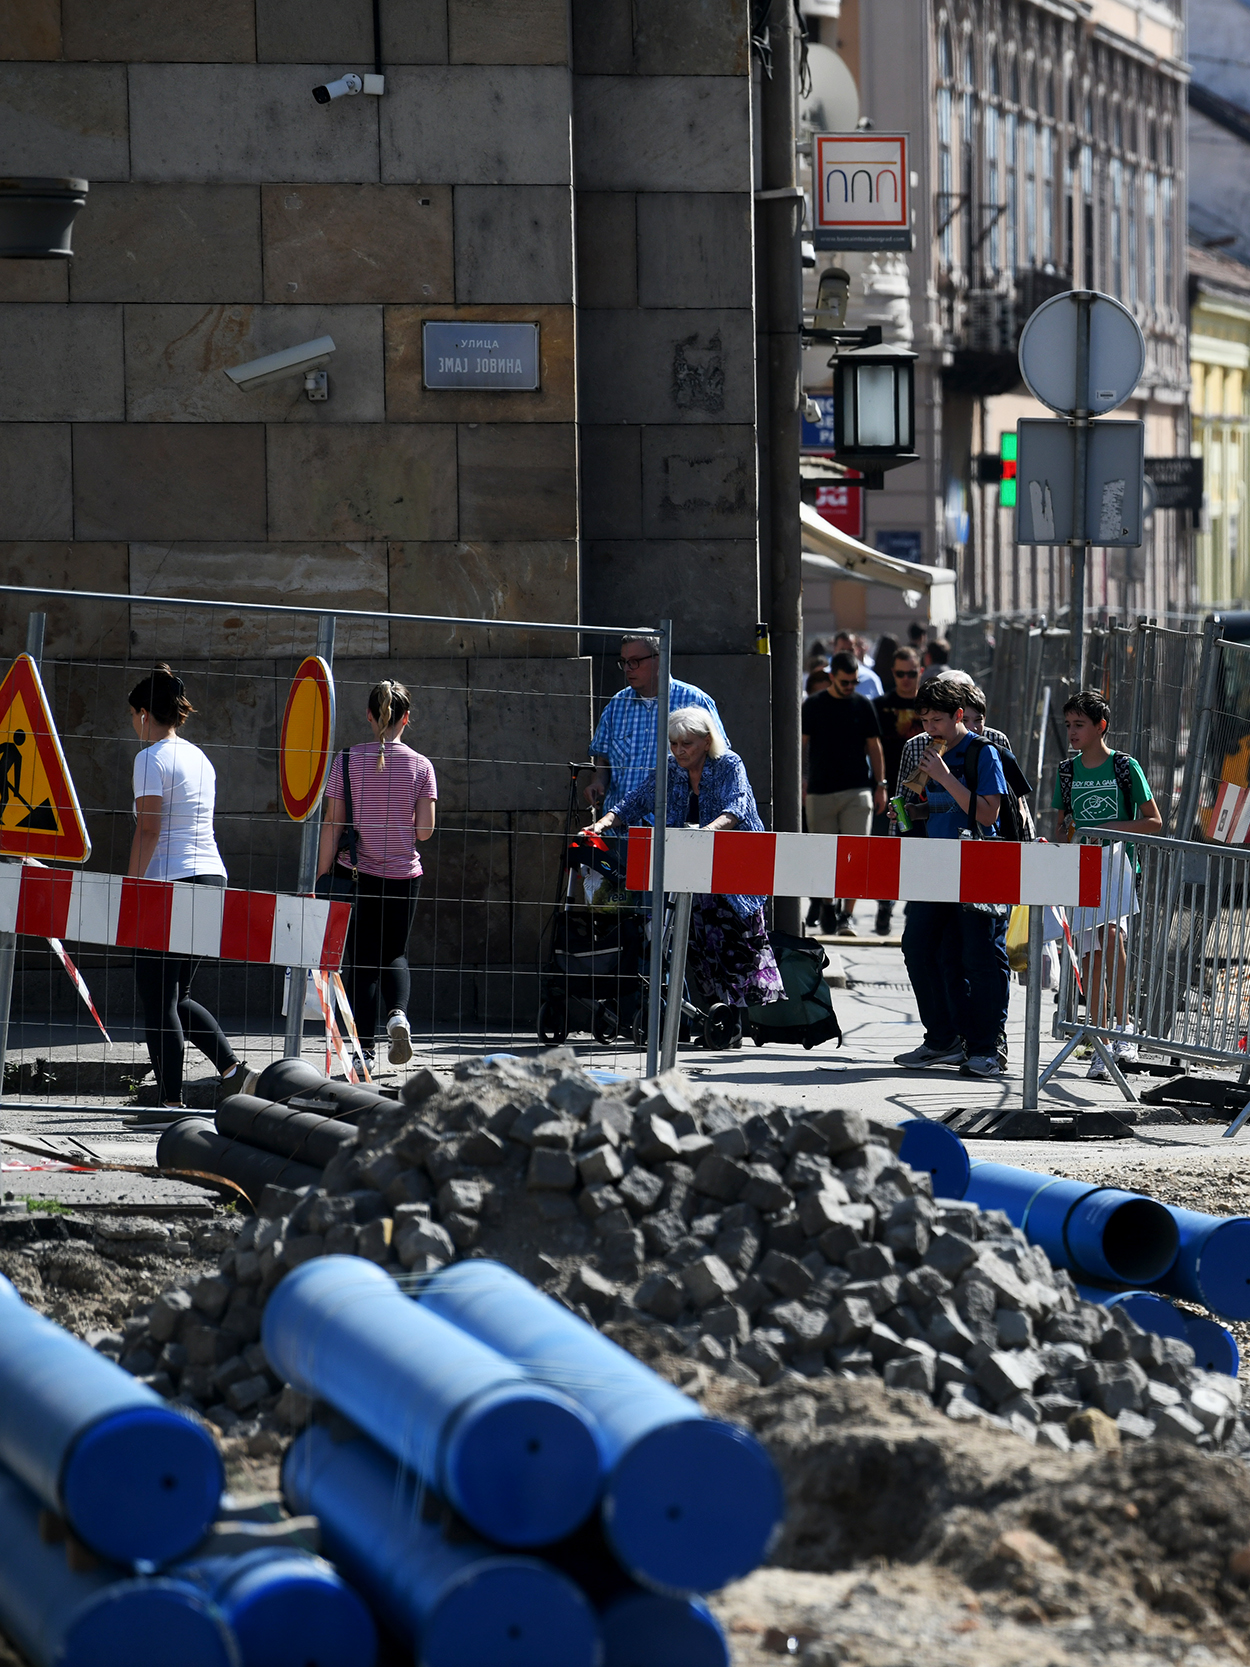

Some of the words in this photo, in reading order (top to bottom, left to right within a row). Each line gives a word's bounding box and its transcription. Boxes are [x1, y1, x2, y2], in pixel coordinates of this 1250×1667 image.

[460, 339, 500, 349] УЛИЦА
[438, 357, 469, 373] ЗМАЈ
[475, 358, 523, 374] ЈОВИНА
[607, 892, 627, 903] real
